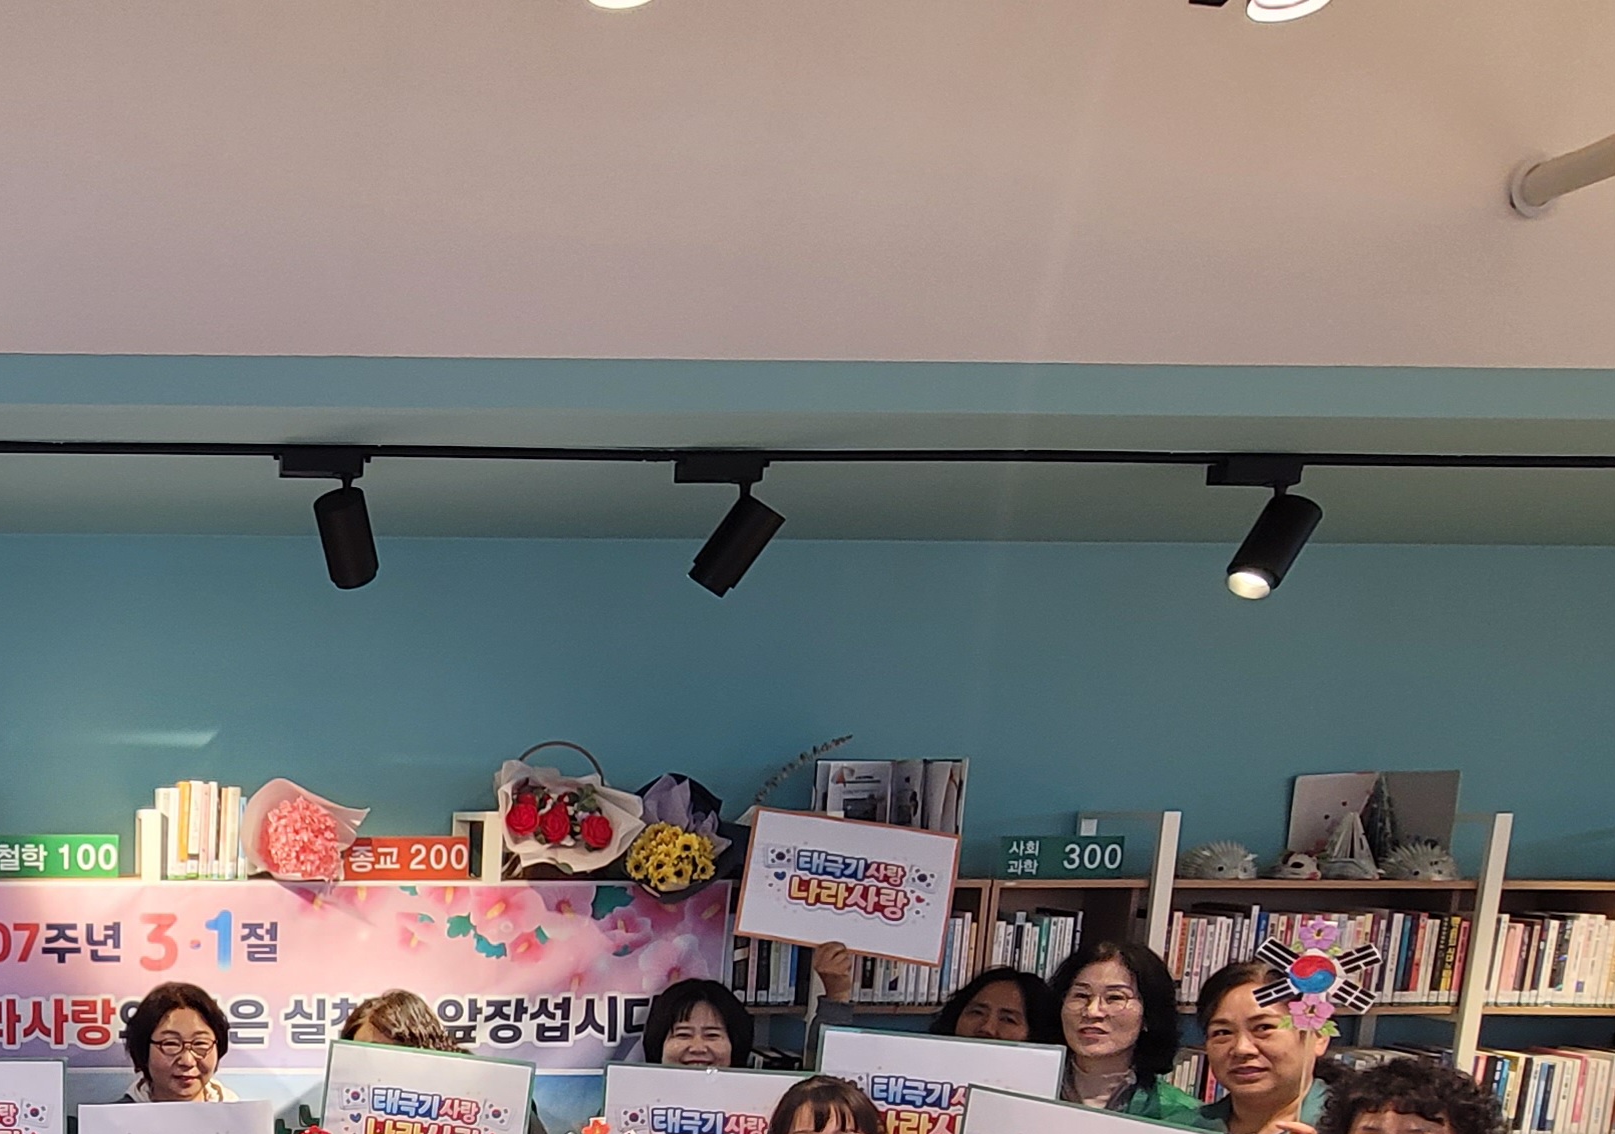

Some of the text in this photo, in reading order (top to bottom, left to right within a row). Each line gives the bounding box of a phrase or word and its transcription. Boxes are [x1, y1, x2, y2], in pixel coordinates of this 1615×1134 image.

[58, 843, 118, 871] 100
[349, 843, 468, 873] 종교 200
[1009, 840, 1040, 856] 사회
[1063, 843, 1122, 870] 300
[1007, 859, 1039, 876] 과학
[789, 875, 911, 922] 나라사랑
